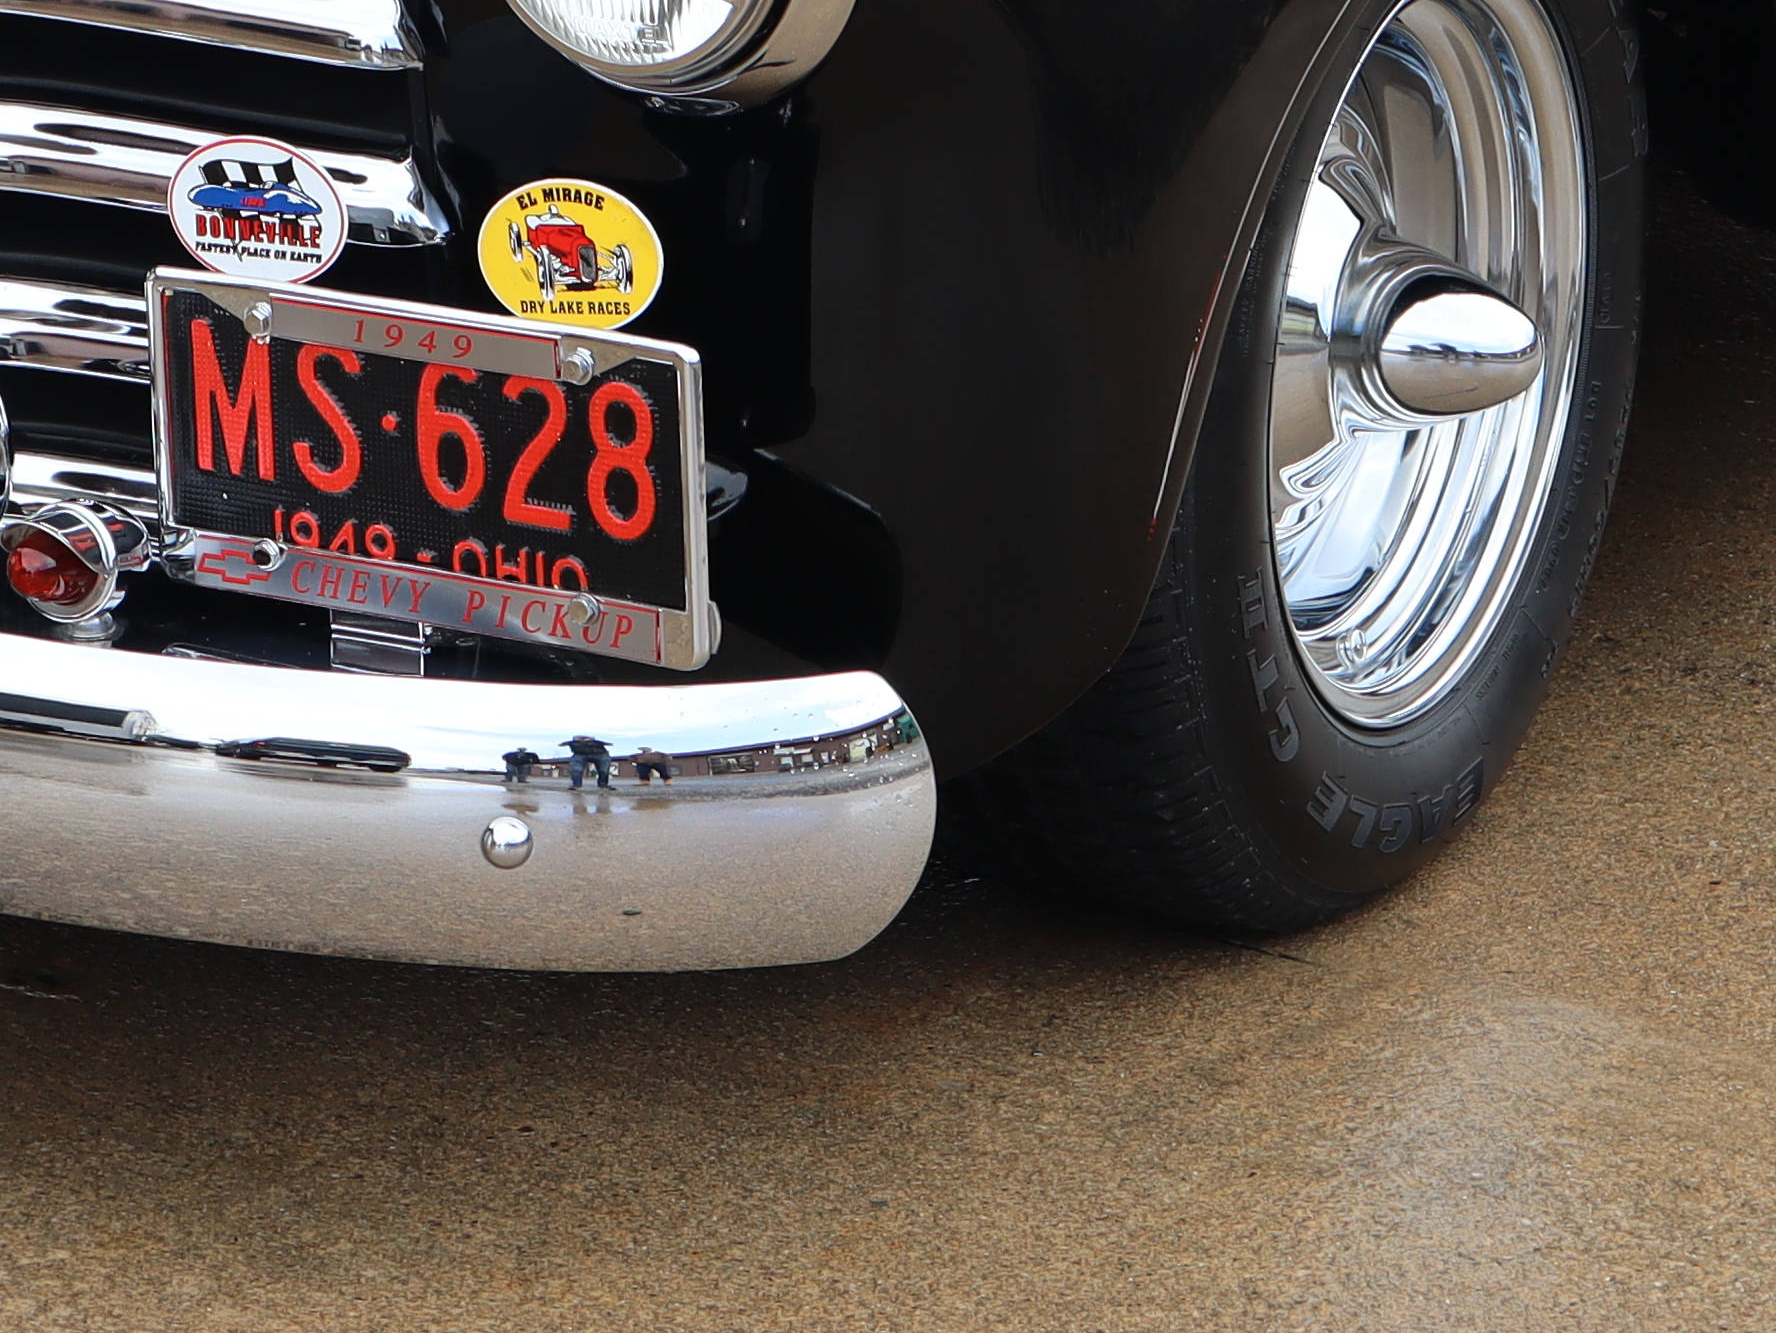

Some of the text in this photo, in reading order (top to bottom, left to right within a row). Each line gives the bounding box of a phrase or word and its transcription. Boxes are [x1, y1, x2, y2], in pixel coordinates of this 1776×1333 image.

[516, 187, 605, 211] EL MIRAGE
[195, 213, 321, 249] BONNEVILLE
[195, 240, 322, 264] FASTEST PLACE ON EARTH
[520, 300, 631, 316] DRY LAKE RACES
[352, 318, 474, 359] 1949
[290, 559, 634, 649] CHEVY PICKUP
[1306, 756, 1484, 853] EAGLE
